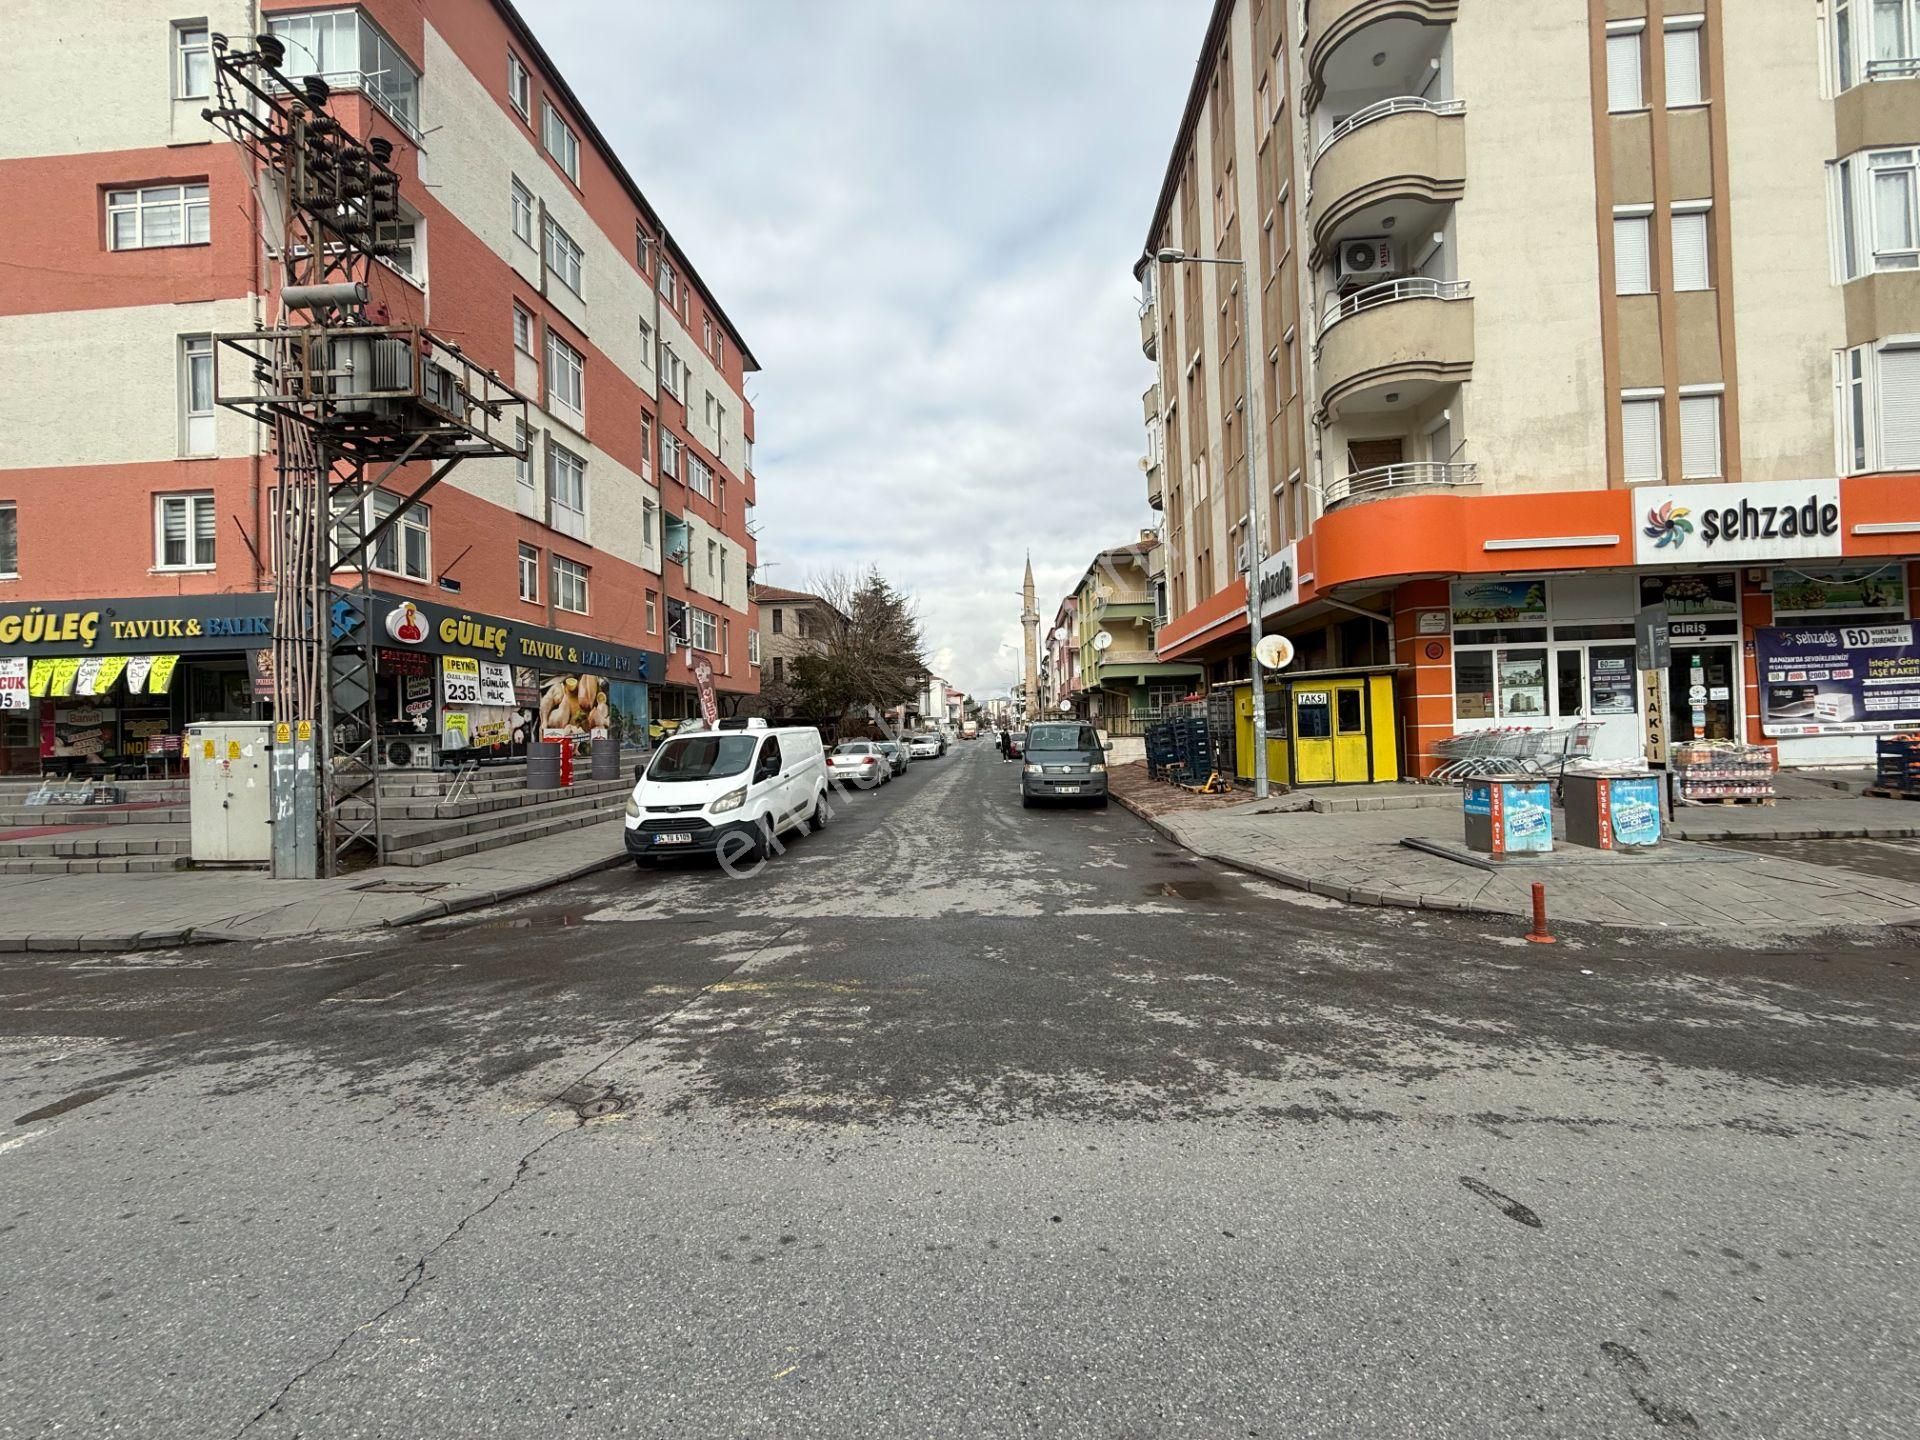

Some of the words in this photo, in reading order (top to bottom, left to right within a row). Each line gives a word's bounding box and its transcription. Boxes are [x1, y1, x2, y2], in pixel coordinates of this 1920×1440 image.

[1701, 495, 1839, 545] şehzade
[0, 607, 100, 648] GÜLEÇ
[111, 619, 183, 639] TAVUK
[185, 618, 202, 637] &
[206, 617, 270, 637] BALIK
[1671, 623, 1707, 635] GİRİŞ
[439, 615, 507, 657] GÜLEÇ
[519, 638, 563, 661] TAVUK
[568, 648, 578, 663] &
[1796, 630, 1838, 646] şehzade
[1846, 629, 1870, 646] 60
[448, 684, 475, 701] 235
[1300, 694, 1327, 704] TAKSİ
